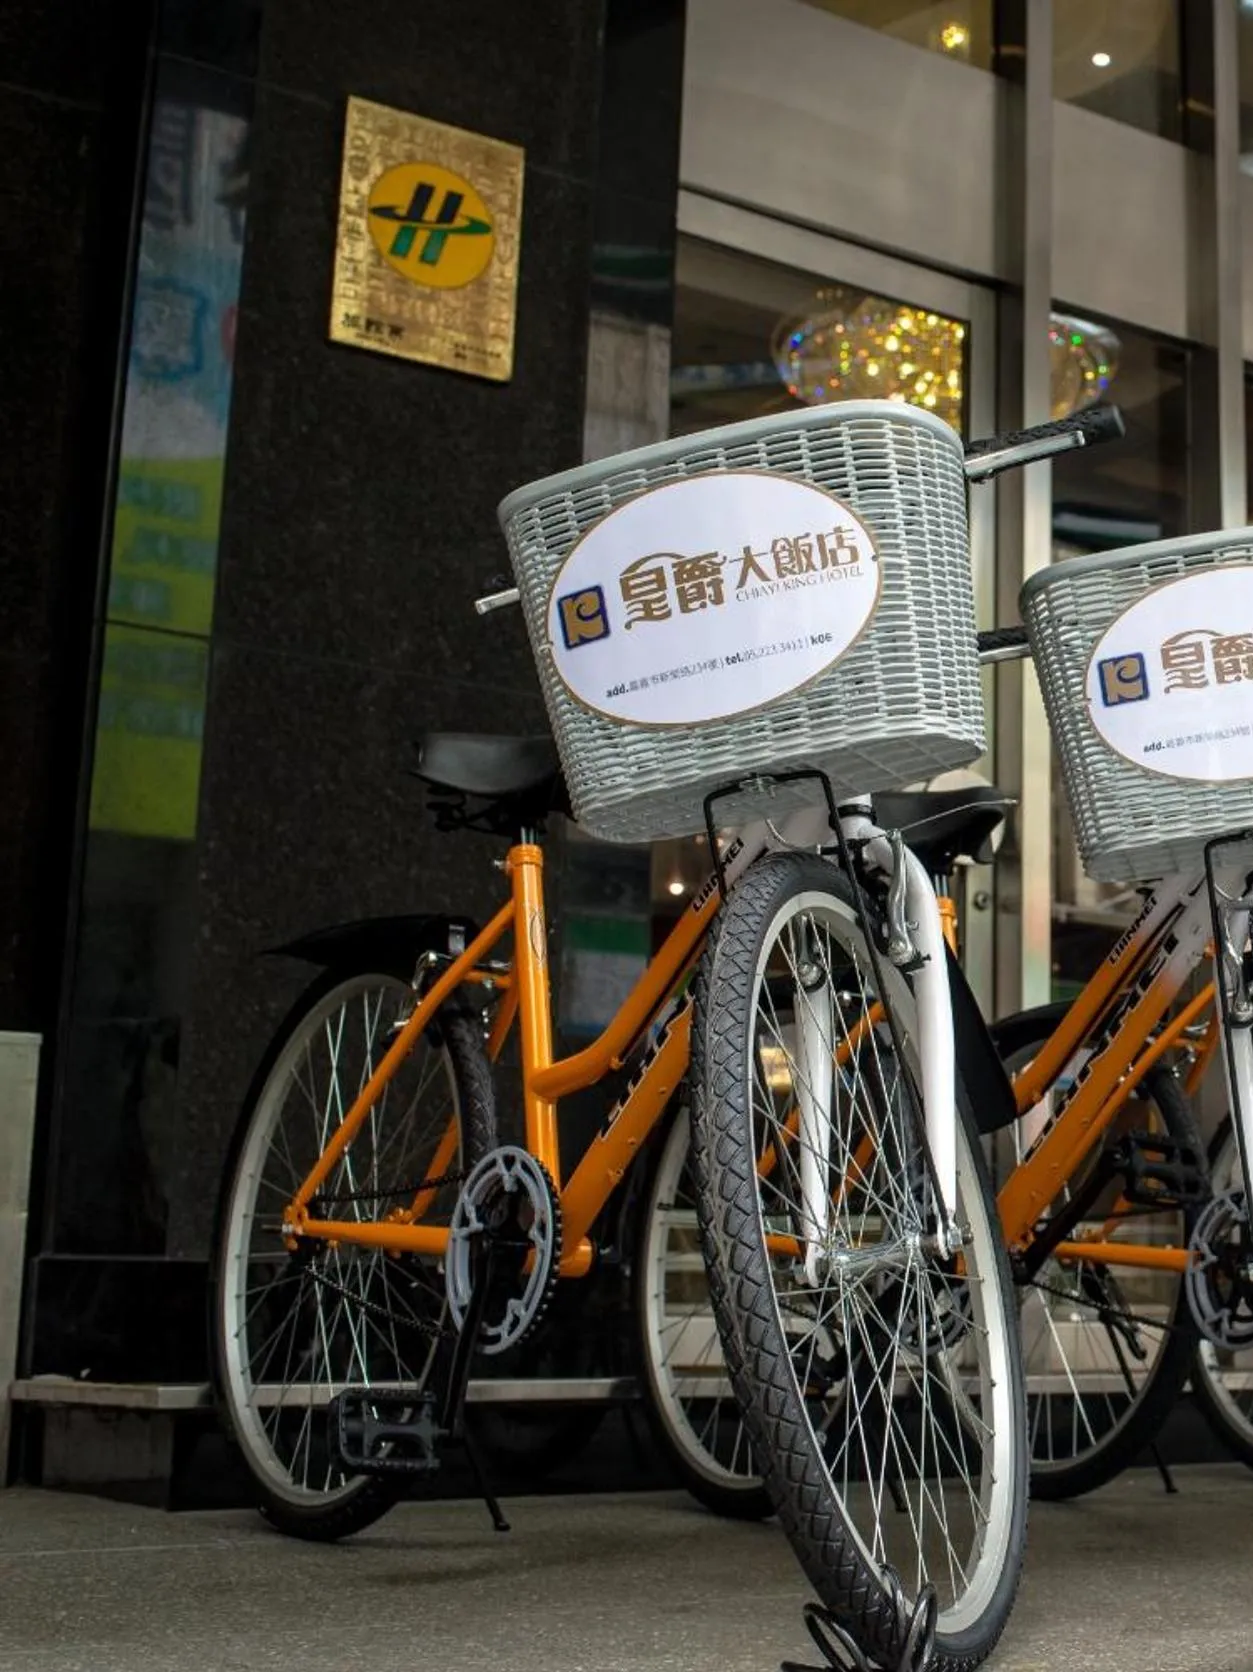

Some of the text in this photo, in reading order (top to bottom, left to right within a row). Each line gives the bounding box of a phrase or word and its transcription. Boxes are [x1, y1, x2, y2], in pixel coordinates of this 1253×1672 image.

[619, 526, 862, 630] 皇爵大飯店
[783, 574, 816, 590] KING
